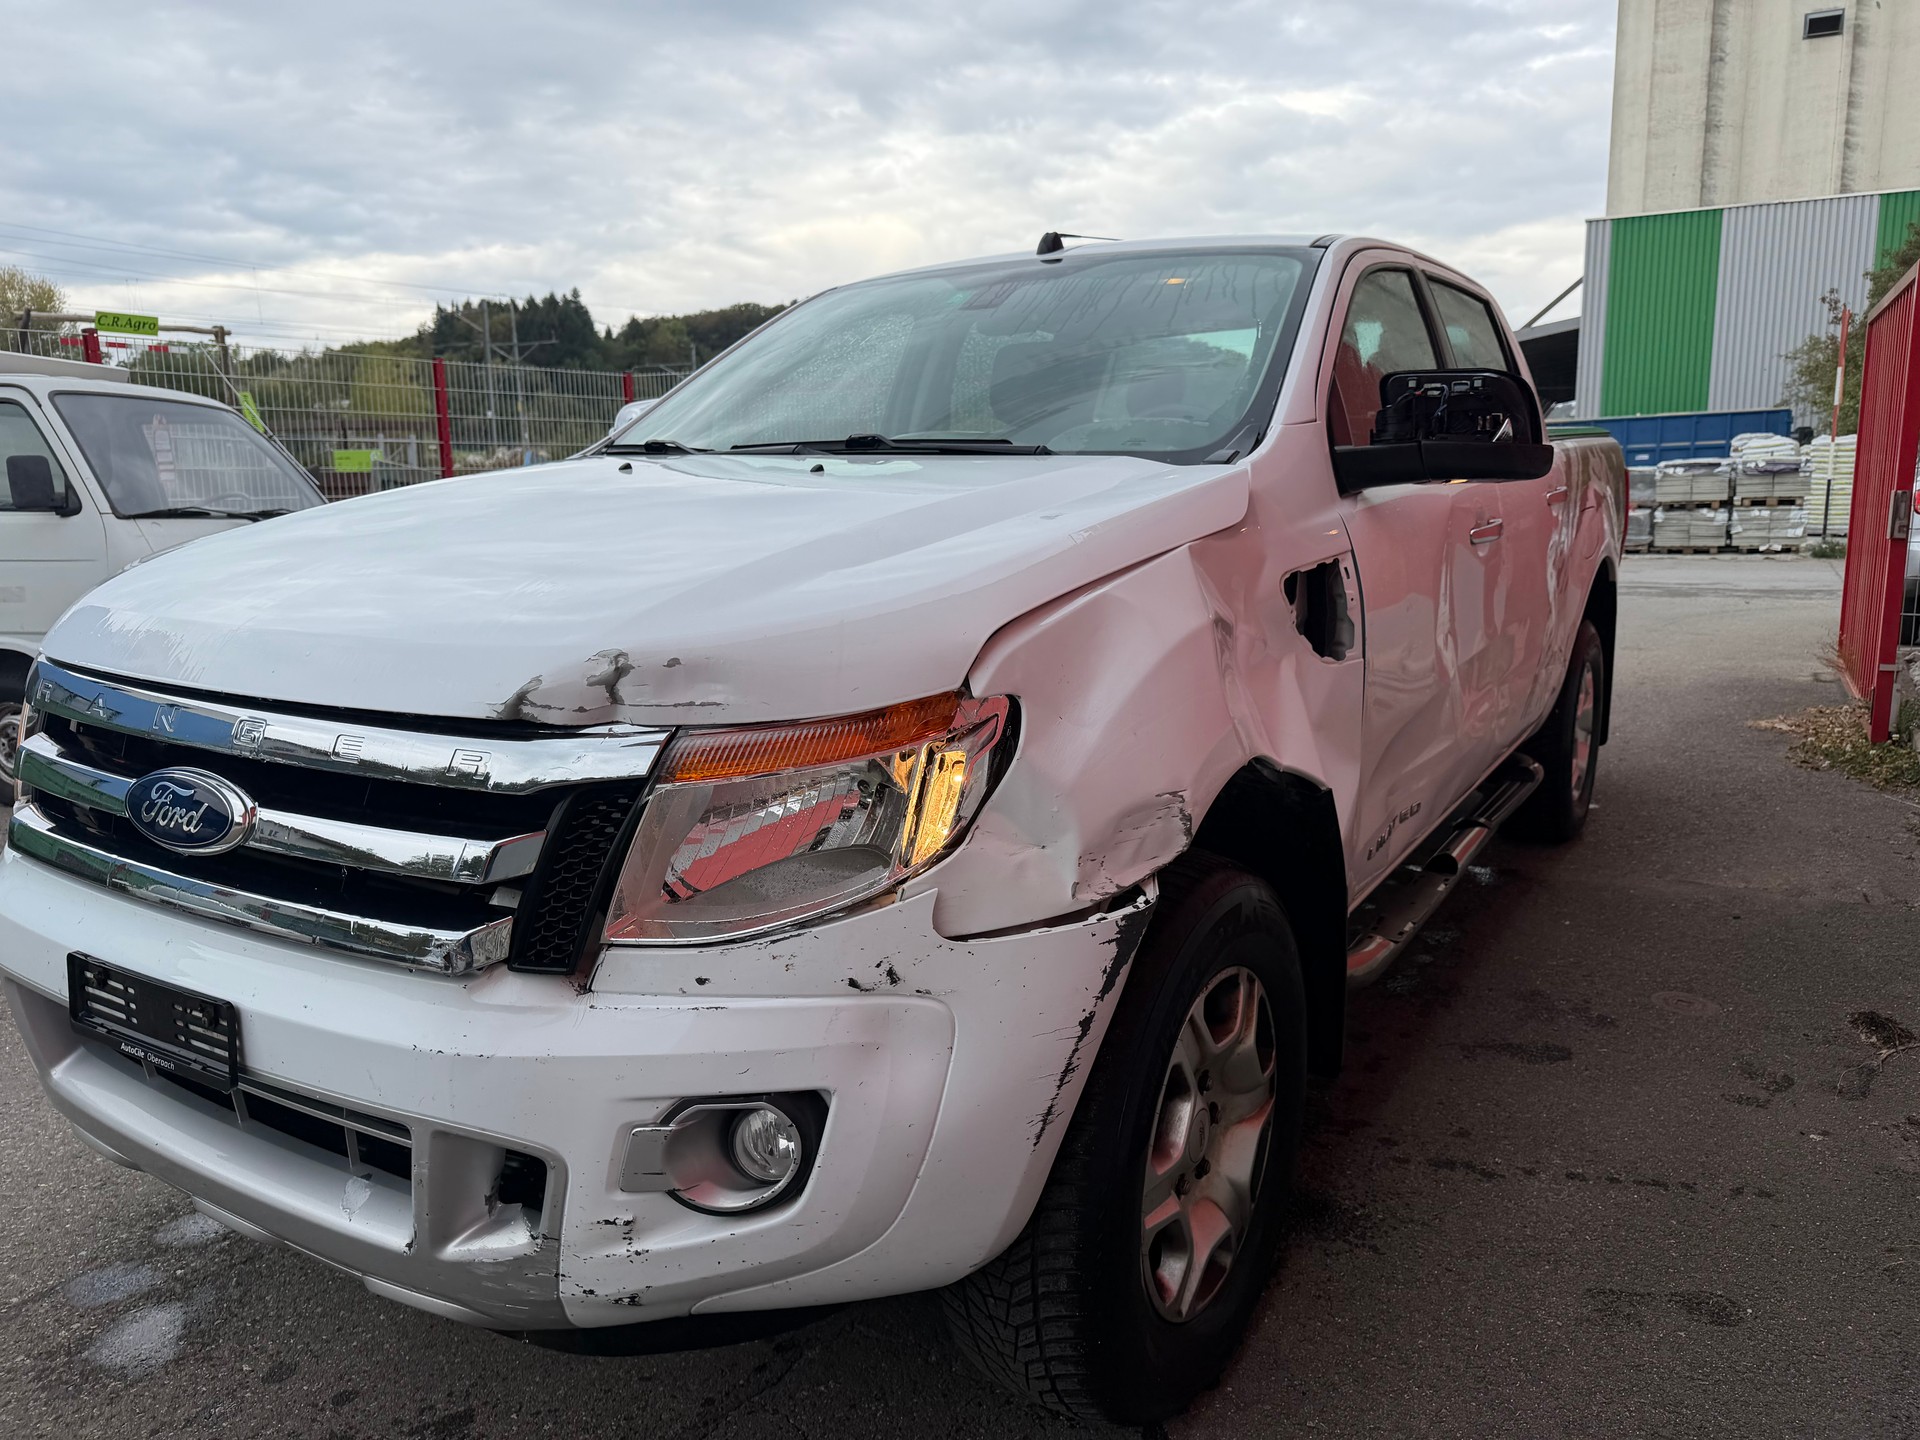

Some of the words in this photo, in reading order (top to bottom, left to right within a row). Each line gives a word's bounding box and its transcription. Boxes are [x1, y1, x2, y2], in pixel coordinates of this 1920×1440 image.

[97, 314, 156, 331] C.R.Agro
[35, 677, 492, 780] RANGER
[141, 781, 208, 834] Ford
